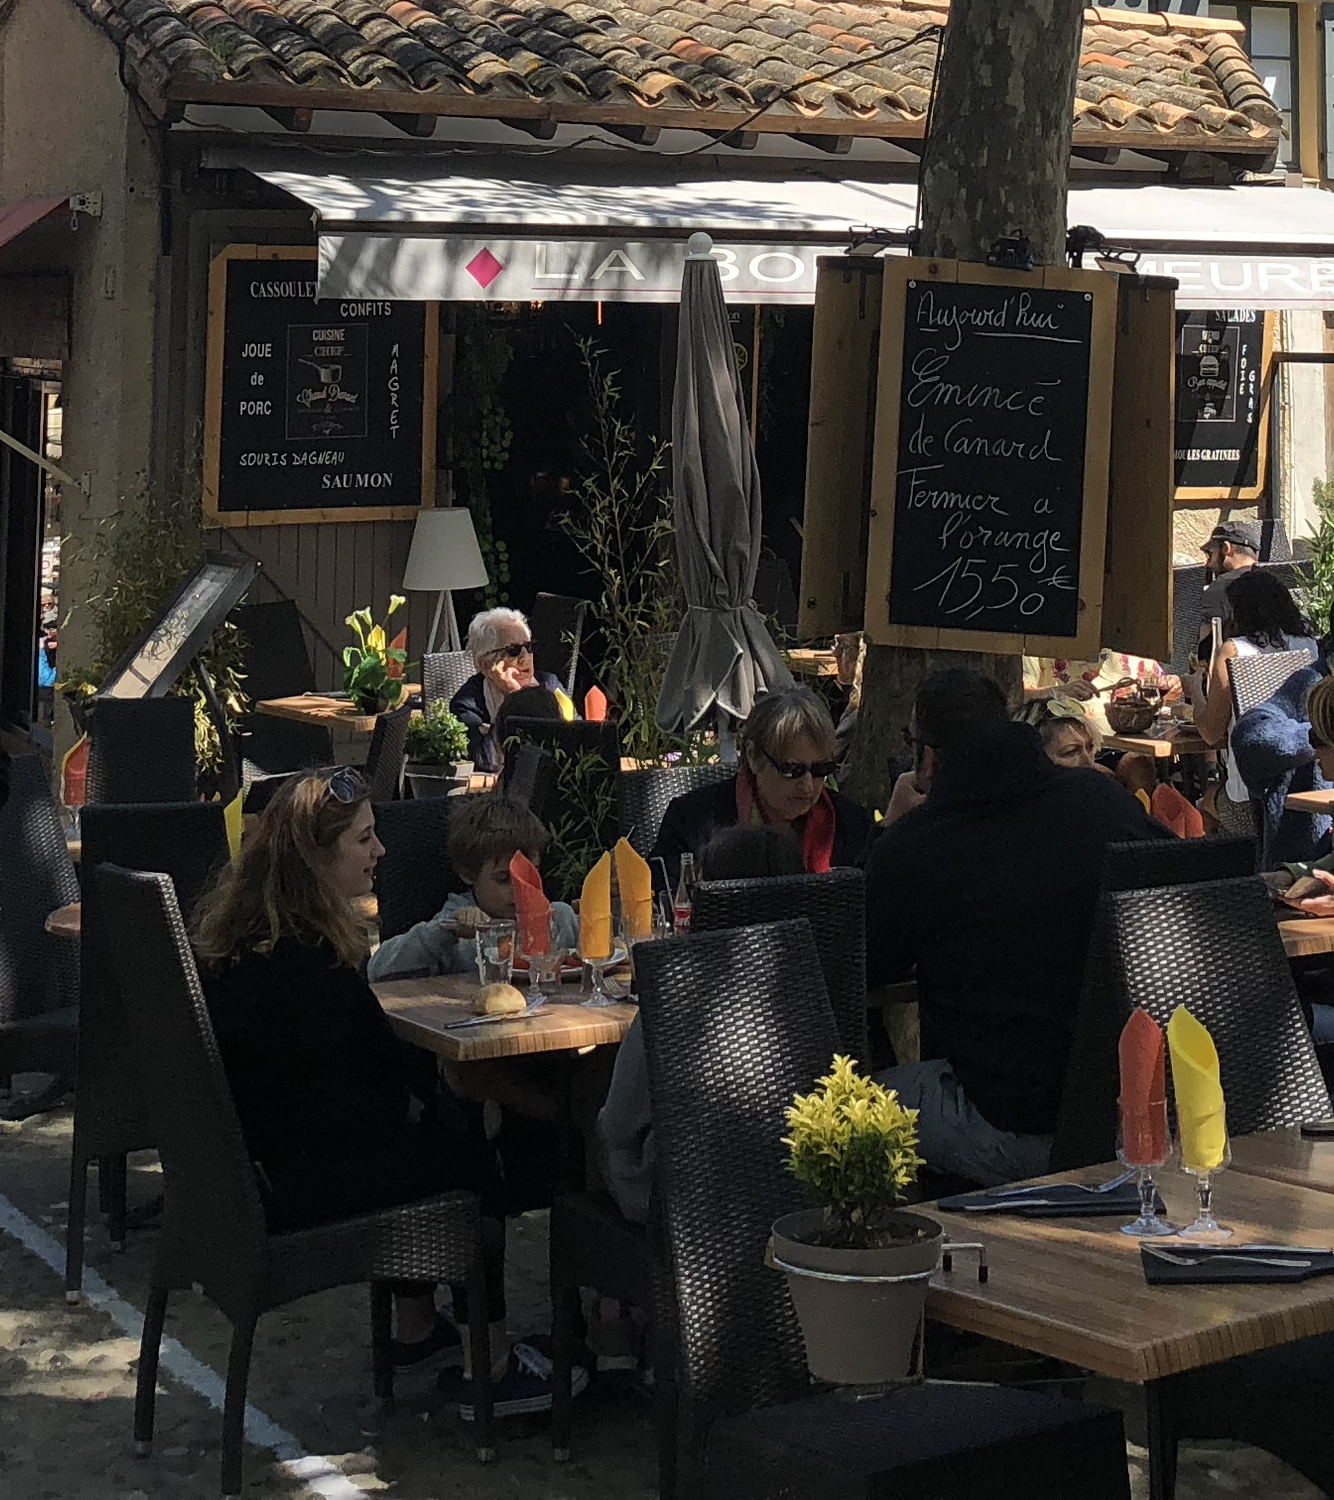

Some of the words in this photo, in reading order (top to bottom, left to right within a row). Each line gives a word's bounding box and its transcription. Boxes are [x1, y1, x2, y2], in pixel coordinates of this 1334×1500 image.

[534, 244, 645, 281] LA
[340, 302, 392, 317] CONFITS
[1215, 309, 1256, 323] SALADES
[312, 329, 346, 341] CUISINE
[241, 343, 272, 358] JOUE
[250, 372, 265, 386] de
[239, 401, 272, 416] PORC
[909, 413, 934, 457] de
[239, 453, 288, 467] SOURIS
[322, 473, 393, 489] SAUMON
